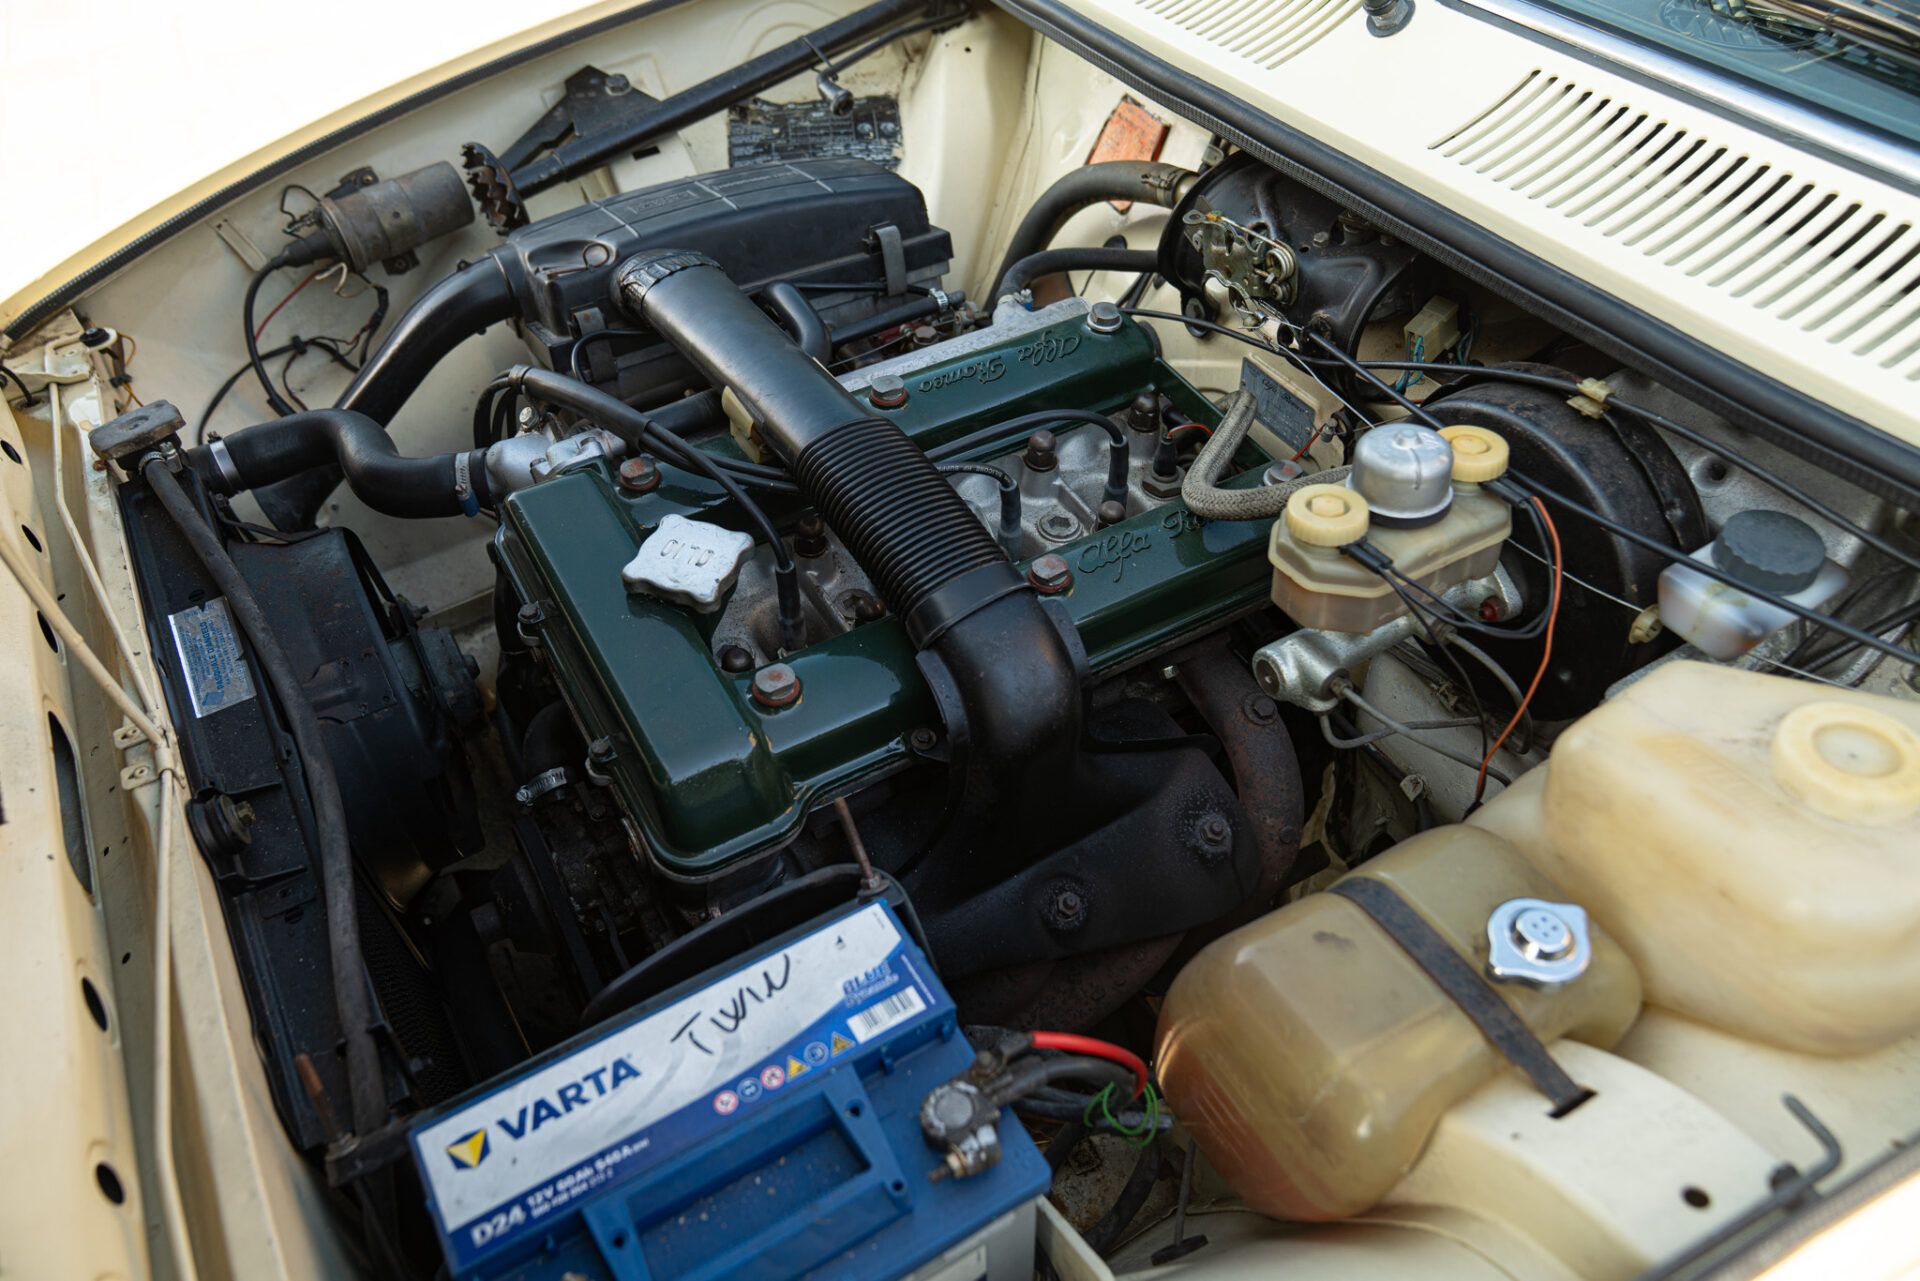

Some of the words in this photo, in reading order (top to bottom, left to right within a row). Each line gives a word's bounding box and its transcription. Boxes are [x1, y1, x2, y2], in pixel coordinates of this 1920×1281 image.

[1017, 330, 1082, 367] Alfa
[918, 354, 1007, 393] Romeo
[660, 538, 715, 568] OLIO
[1077, 531, 1152, 584] Alfa
[670, 952, 791, 1056] TWIN
[496, 1057, 642, 1140] VARTA
[470, 1204, 527, 1249] D24
